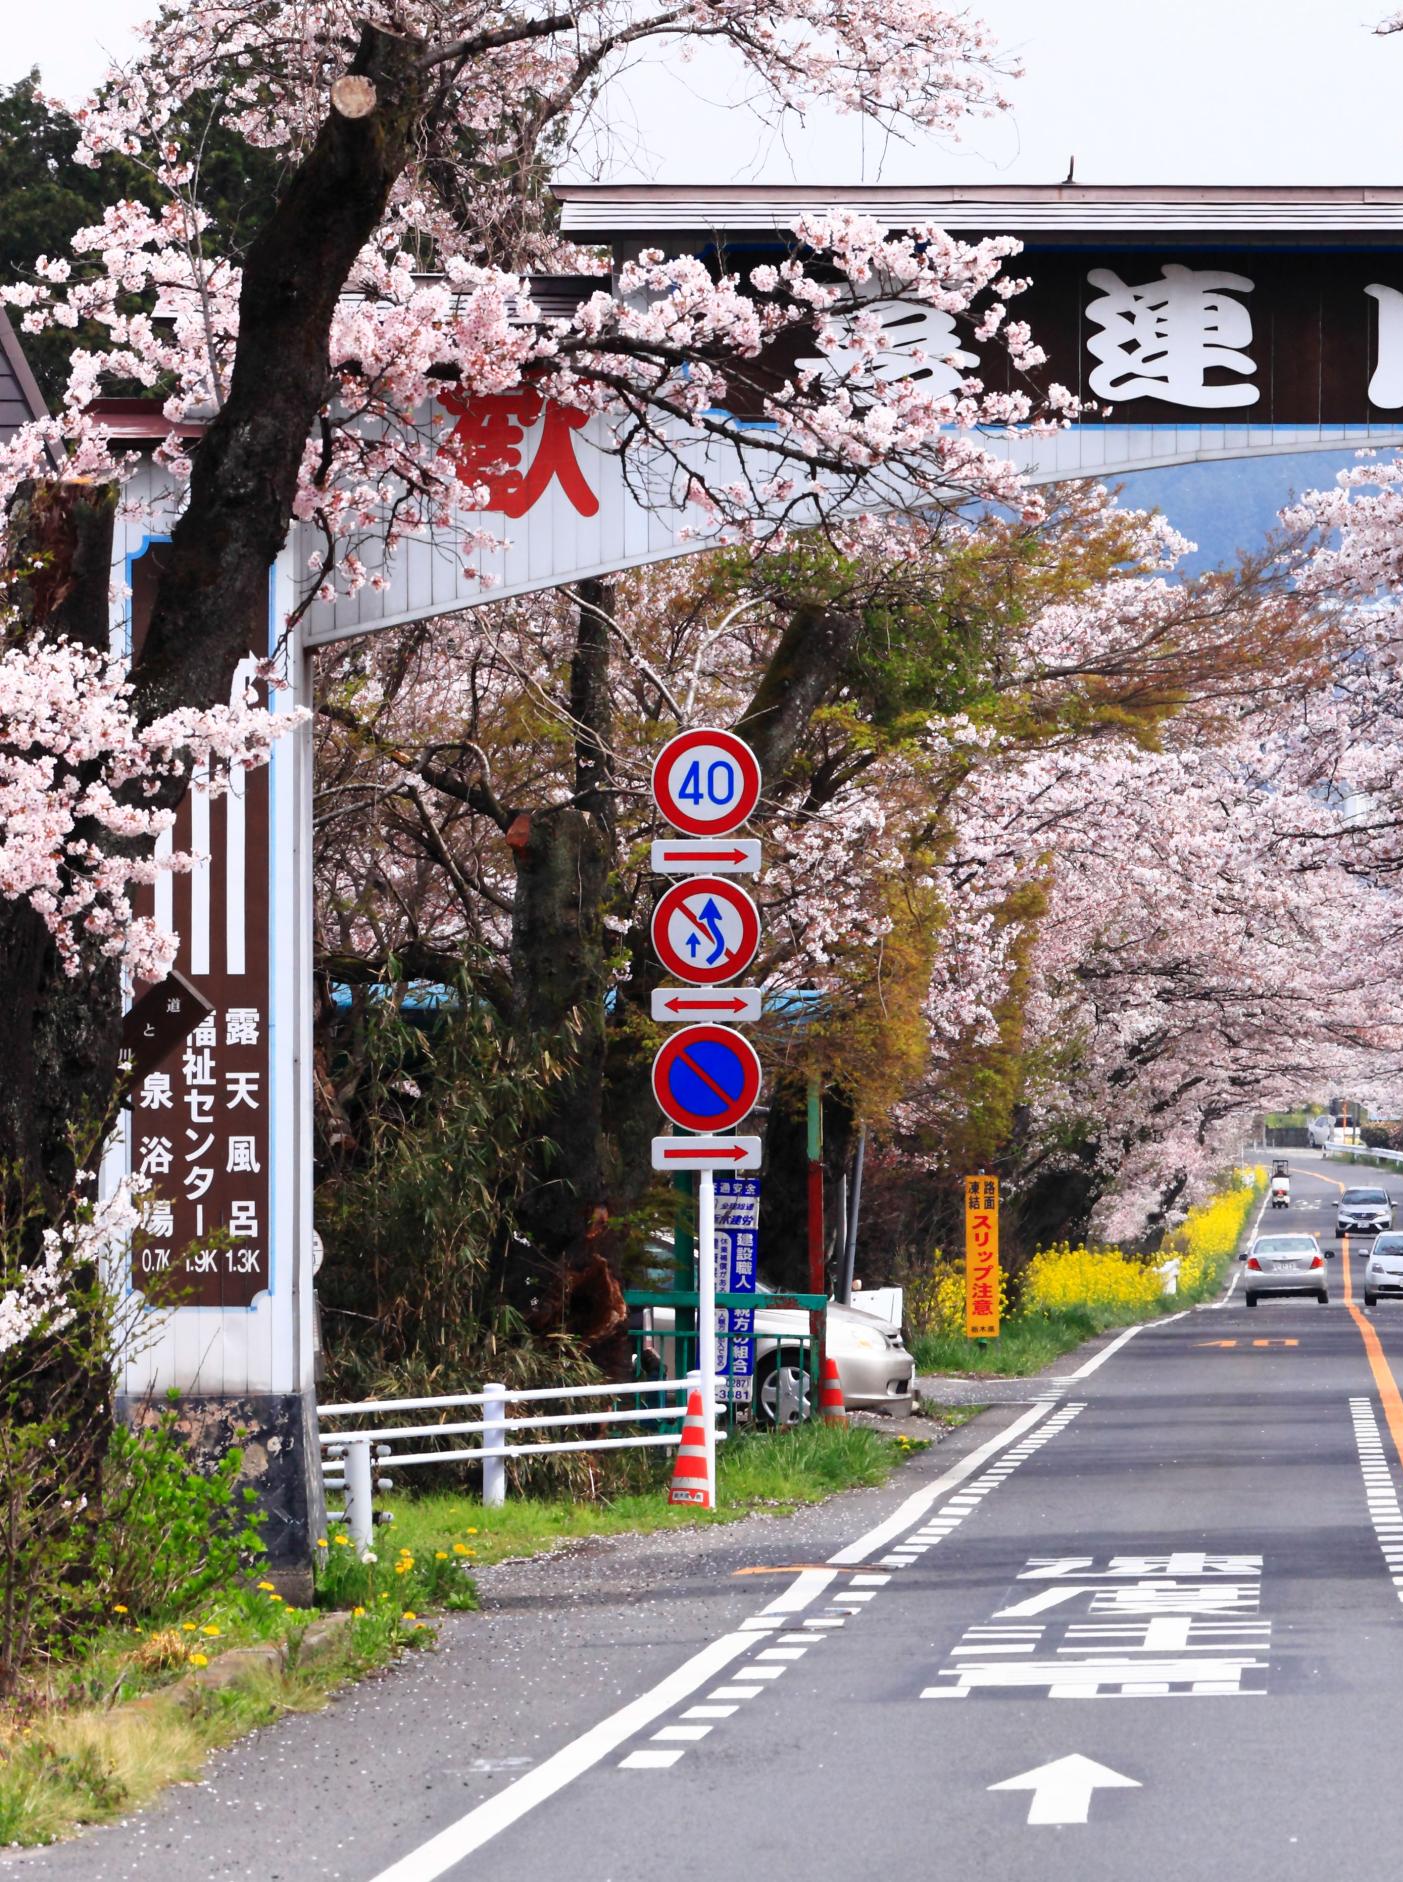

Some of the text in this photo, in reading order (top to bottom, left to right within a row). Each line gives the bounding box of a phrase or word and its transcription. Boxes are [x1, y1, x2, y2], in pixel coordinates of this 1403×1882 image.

[678, 760, 734, 805] 40
[182, 1010, 217, 1236] 福祉センター
[226, 1008, 260, 1238] 露天風呂
[225, 1249, 261, 1273] 1.3K
[972, 1215, 993, 1315] スリップ注意
